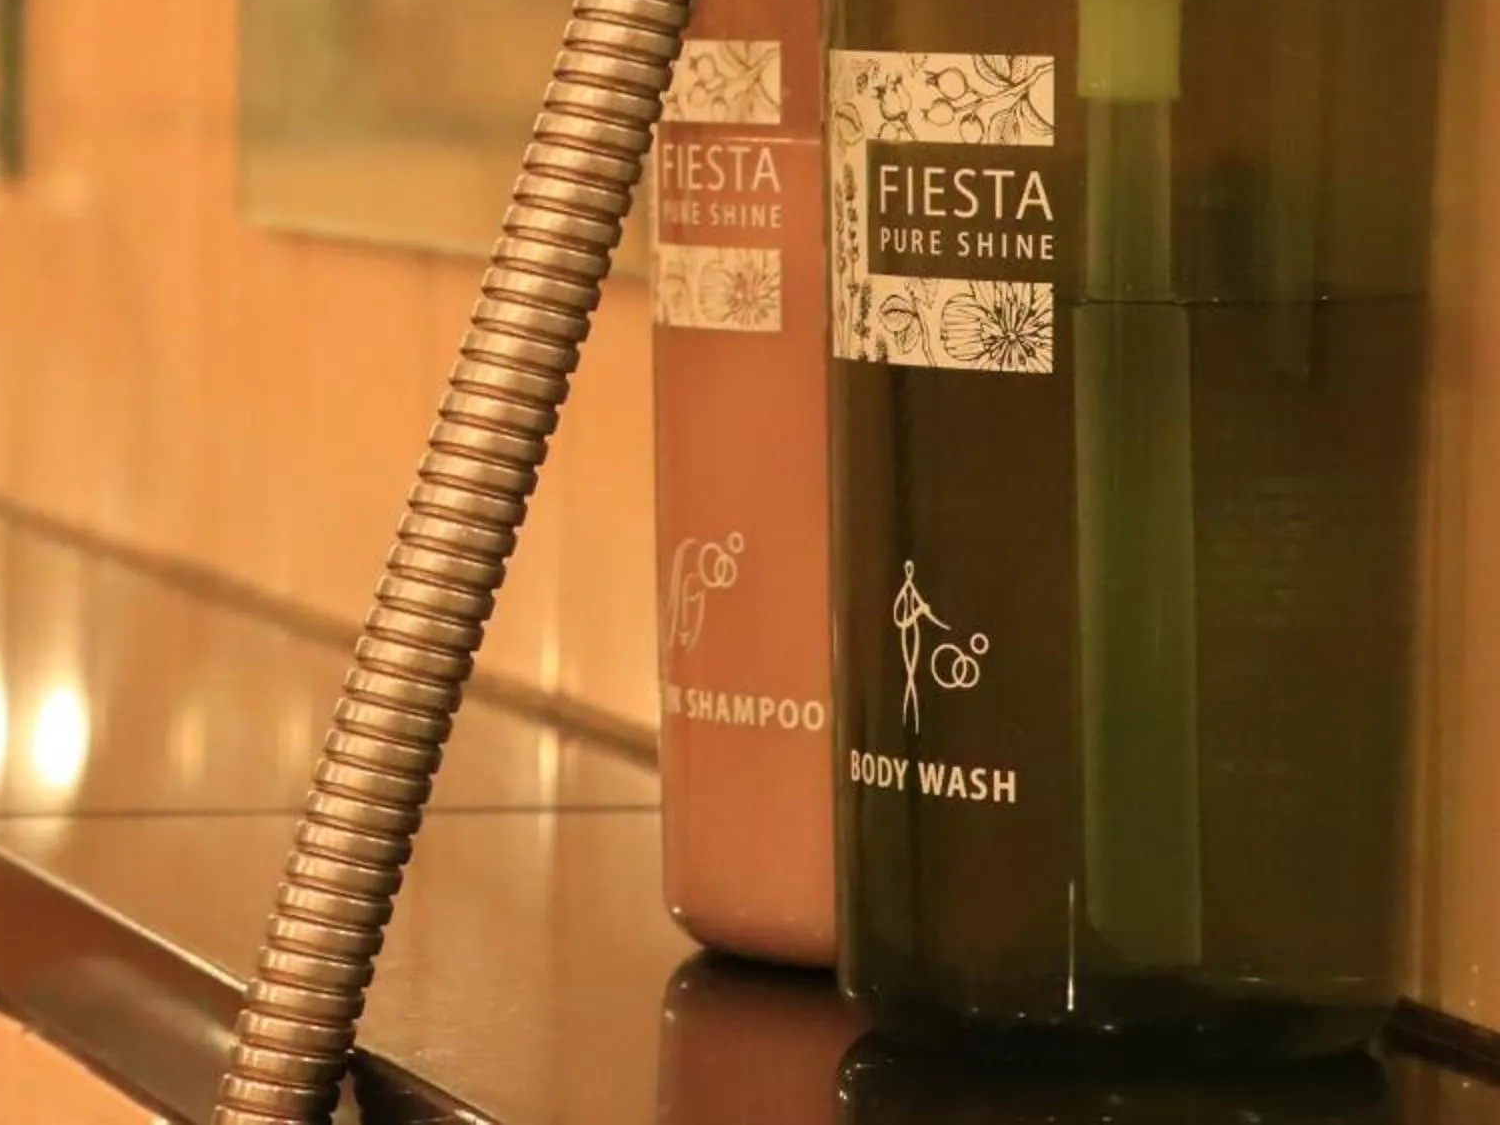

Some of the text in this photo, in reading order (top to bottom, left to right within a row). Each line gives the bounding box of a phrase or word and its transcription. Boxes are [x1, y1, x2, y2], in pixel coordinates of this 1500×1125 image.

[662, 143, 782, 193] FIESTA
[709, 202, 783, 229] SHINE
[879, 165, 1054, 221] FIESTA
[880, 226, 1055, 261] PURE SHINE
[686, 688, 825, 731] SHAMPOO
[850, 749, 1017, 803] BODY WASH
